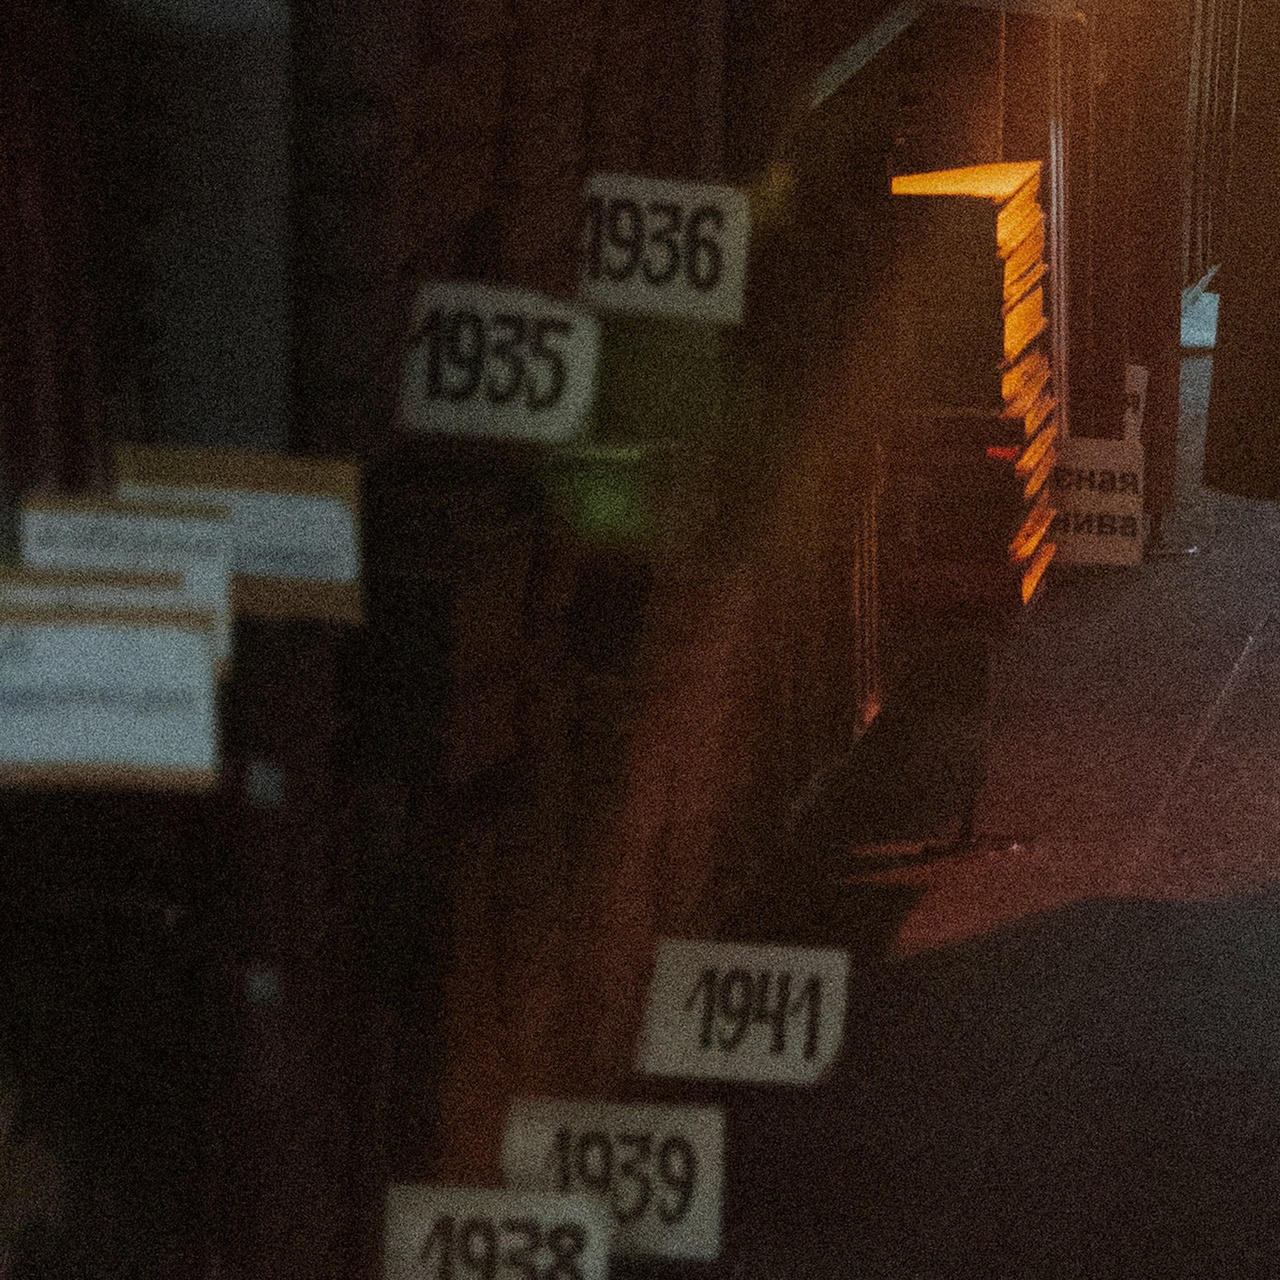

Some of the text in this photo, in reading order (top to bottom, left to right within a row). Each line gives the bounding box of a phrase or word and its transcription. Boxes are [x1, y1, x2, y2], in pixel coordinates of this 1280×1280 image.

[583, 196, 724, 292] 1936
[410, 309, 572, 410] 1935
[684, 968, 822, 1060] 1941
[551, 1126, 697, 1226] 1939
